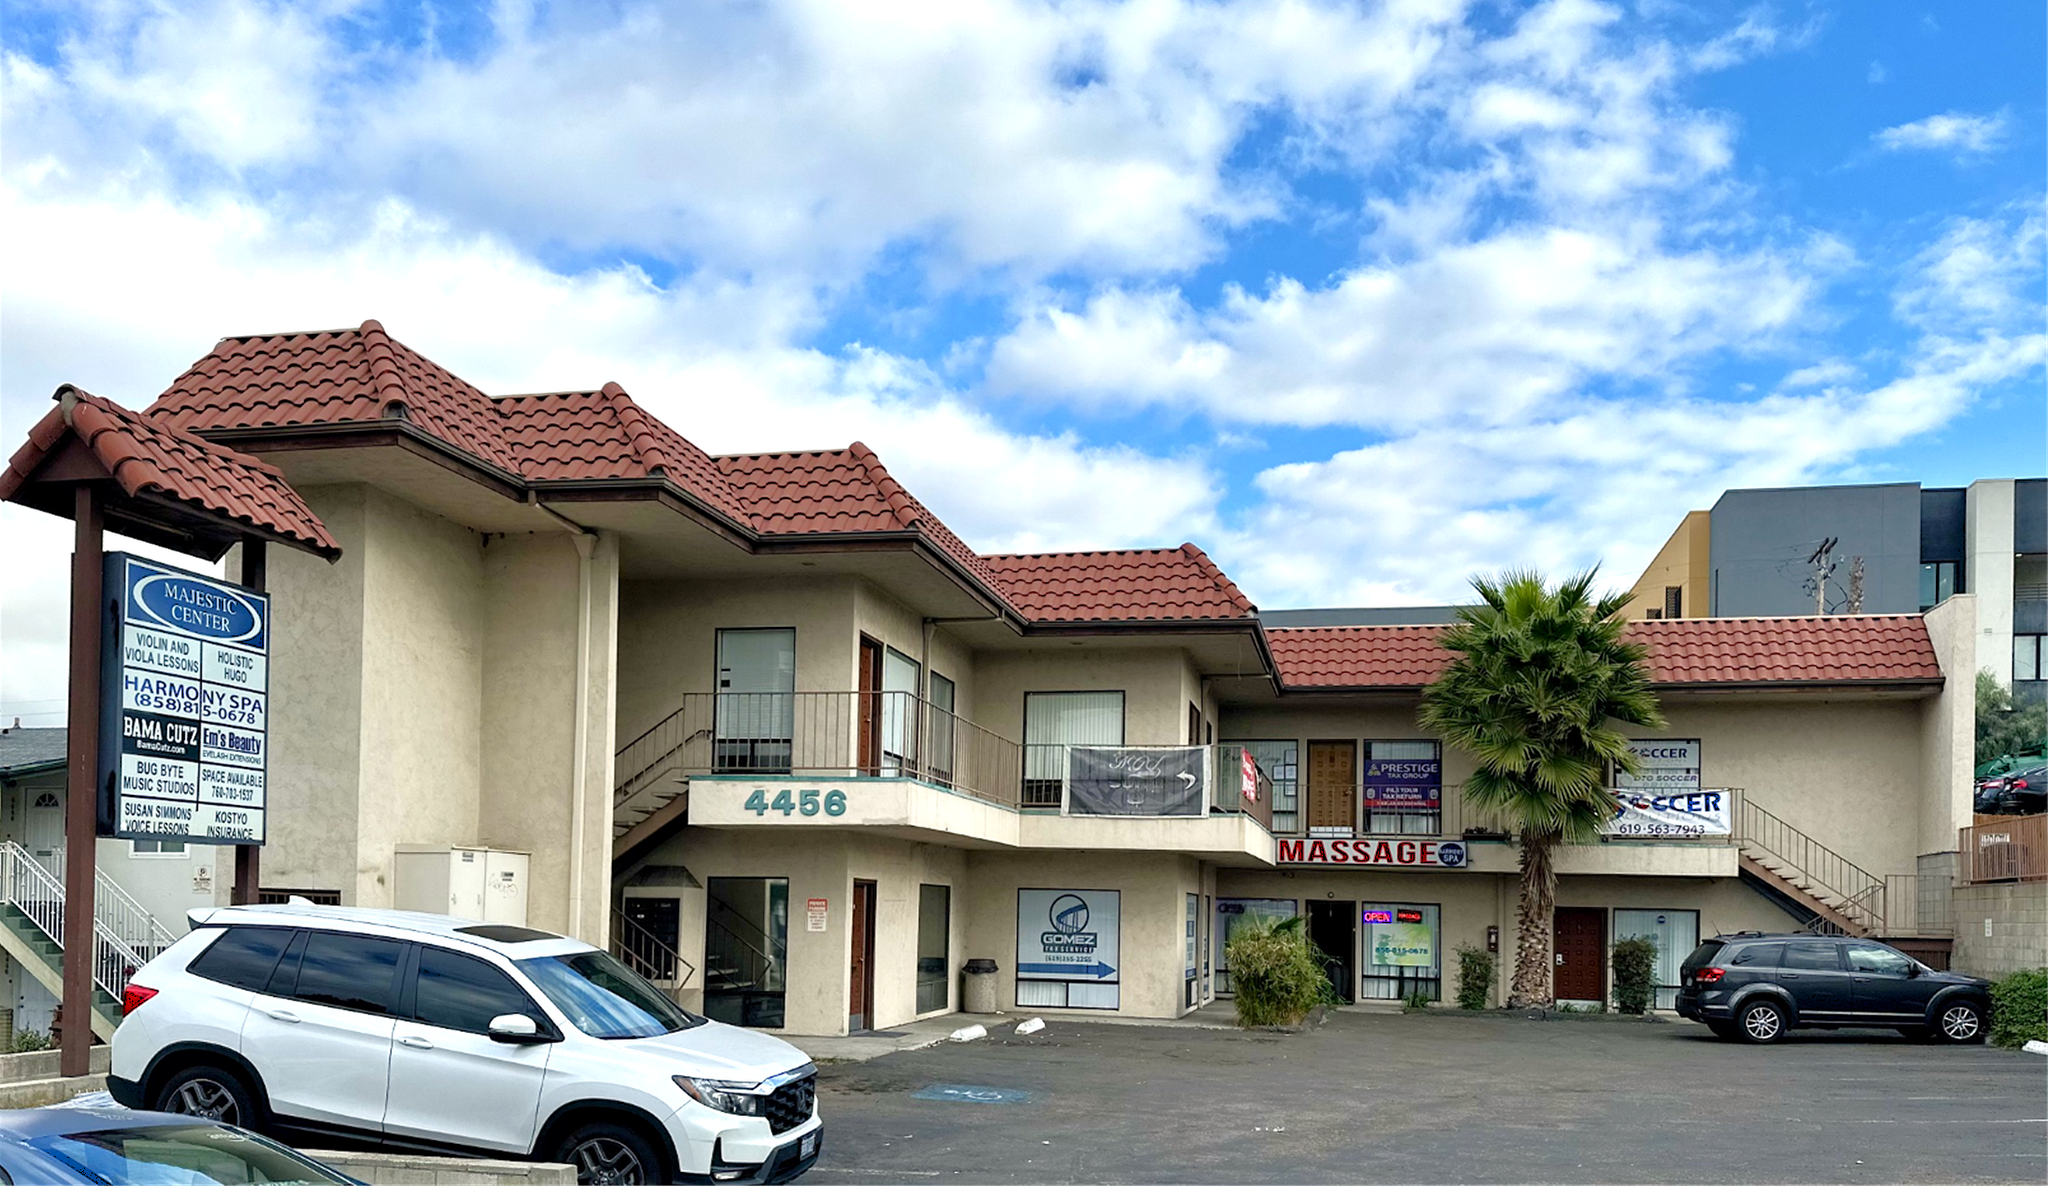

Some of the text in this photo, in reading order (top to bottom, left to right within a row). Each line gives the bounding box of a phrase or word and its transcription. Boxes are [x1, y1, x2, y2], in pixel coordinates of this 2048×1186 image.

[164, 582, 238, 615] MAJESTIC
[171, 604, 231, 633] CENTER
[136, 632, 190, 656] VIOLIN AND
[125, 646, 199, 674] VIOLA LESSONS
[217, 650, 254, 670] HOLISTIC
[224, 667, 247, 684] HUGO
[124, 674, 263, 714] HARMONY SPA
[134, 692, 256, 725] (858)815-0678
[123, 716, 198, 746] BAMA CUTZ
[203, 728, 262, 754] Em's Beauty
[136, 739, 187, 755] BamaCutz.com
[202, 749, 262, 765] EYELASH EXTENSIONS
[136, 761, 184, 779] BUG BYTE
[1380, 763, 1438, 773] PRESTIGE
[123, 775, 195, 796] MUSIC STUDIOS
[201, 768, 263, 789] SPACE AVAILABLE
[124, 802, 192, 821] SUSAN SIMMONS
[744, 789, 847, 817] 4456
[126, 819, 190, 836] VOICE LESSONS
[214, 810, 248, 825] KOSTYO
[206, 824, 254, 840] INSURANCE
[1278, 839, 1438, 864] MASSAGE
[1443, 854, 1460, 863] SPA
[1364, 912, 1390, 922] OPEN
[1043, 934, 1095, 945] GOMEZ
